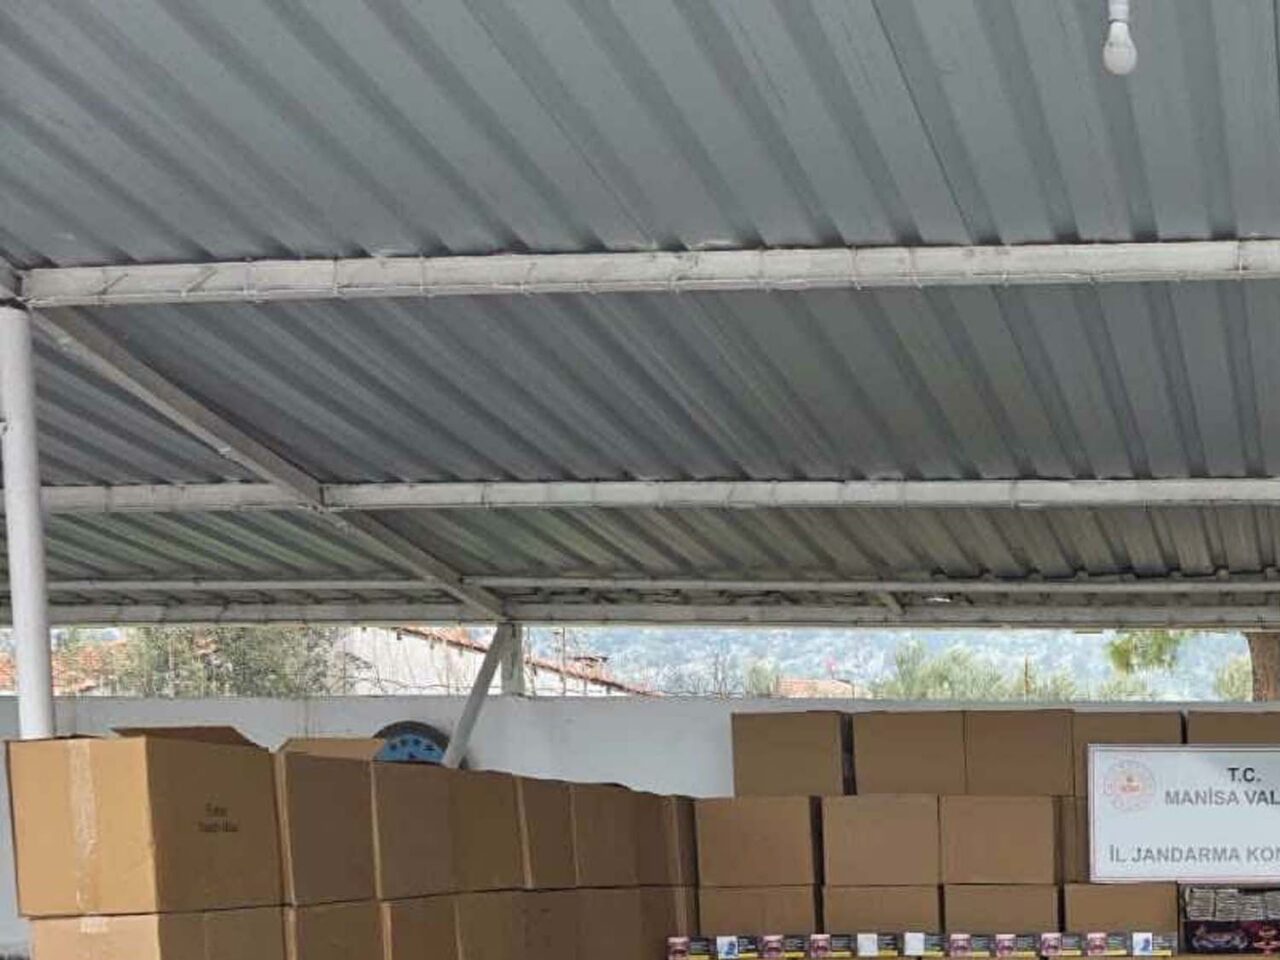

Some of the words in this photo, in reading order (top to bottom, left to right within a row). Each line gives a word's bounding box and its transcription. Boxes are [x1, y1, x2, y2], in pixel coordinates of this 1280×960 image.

[1227, 767, 1262, 783] T.C.
[1164, 787, 1240, 806] MANİSA
[1131, 846, 1240, 863] JANDARMA
